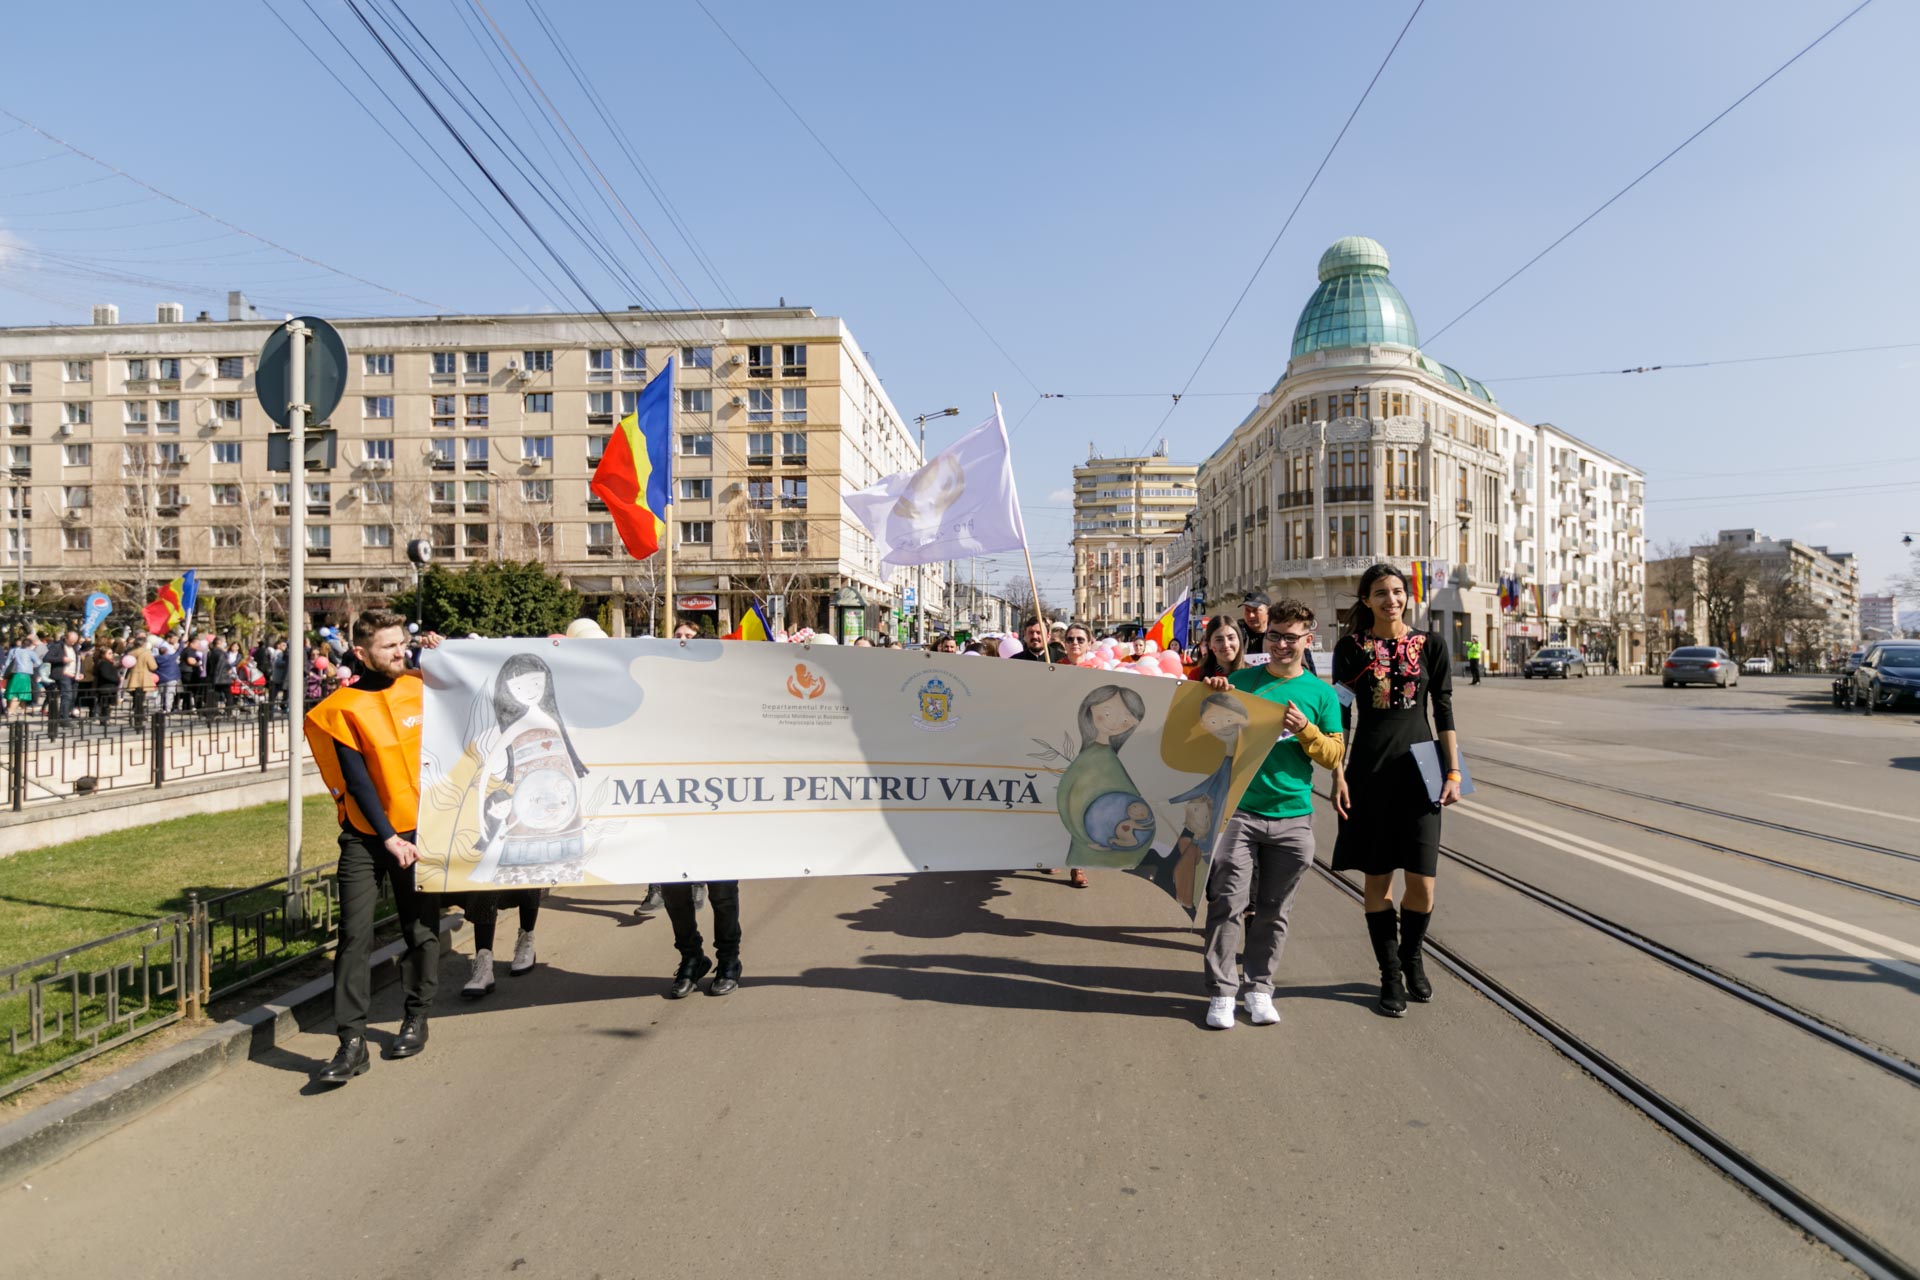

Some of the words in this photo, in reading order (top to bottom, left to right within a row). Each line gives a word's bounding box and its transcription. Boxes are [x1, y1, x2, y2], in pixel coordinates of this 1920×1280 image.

[761, 703, 818, 712] Departamentul
[820, 704, 833, 712] Pro
[783, 776, 930, 802] PENTRU
